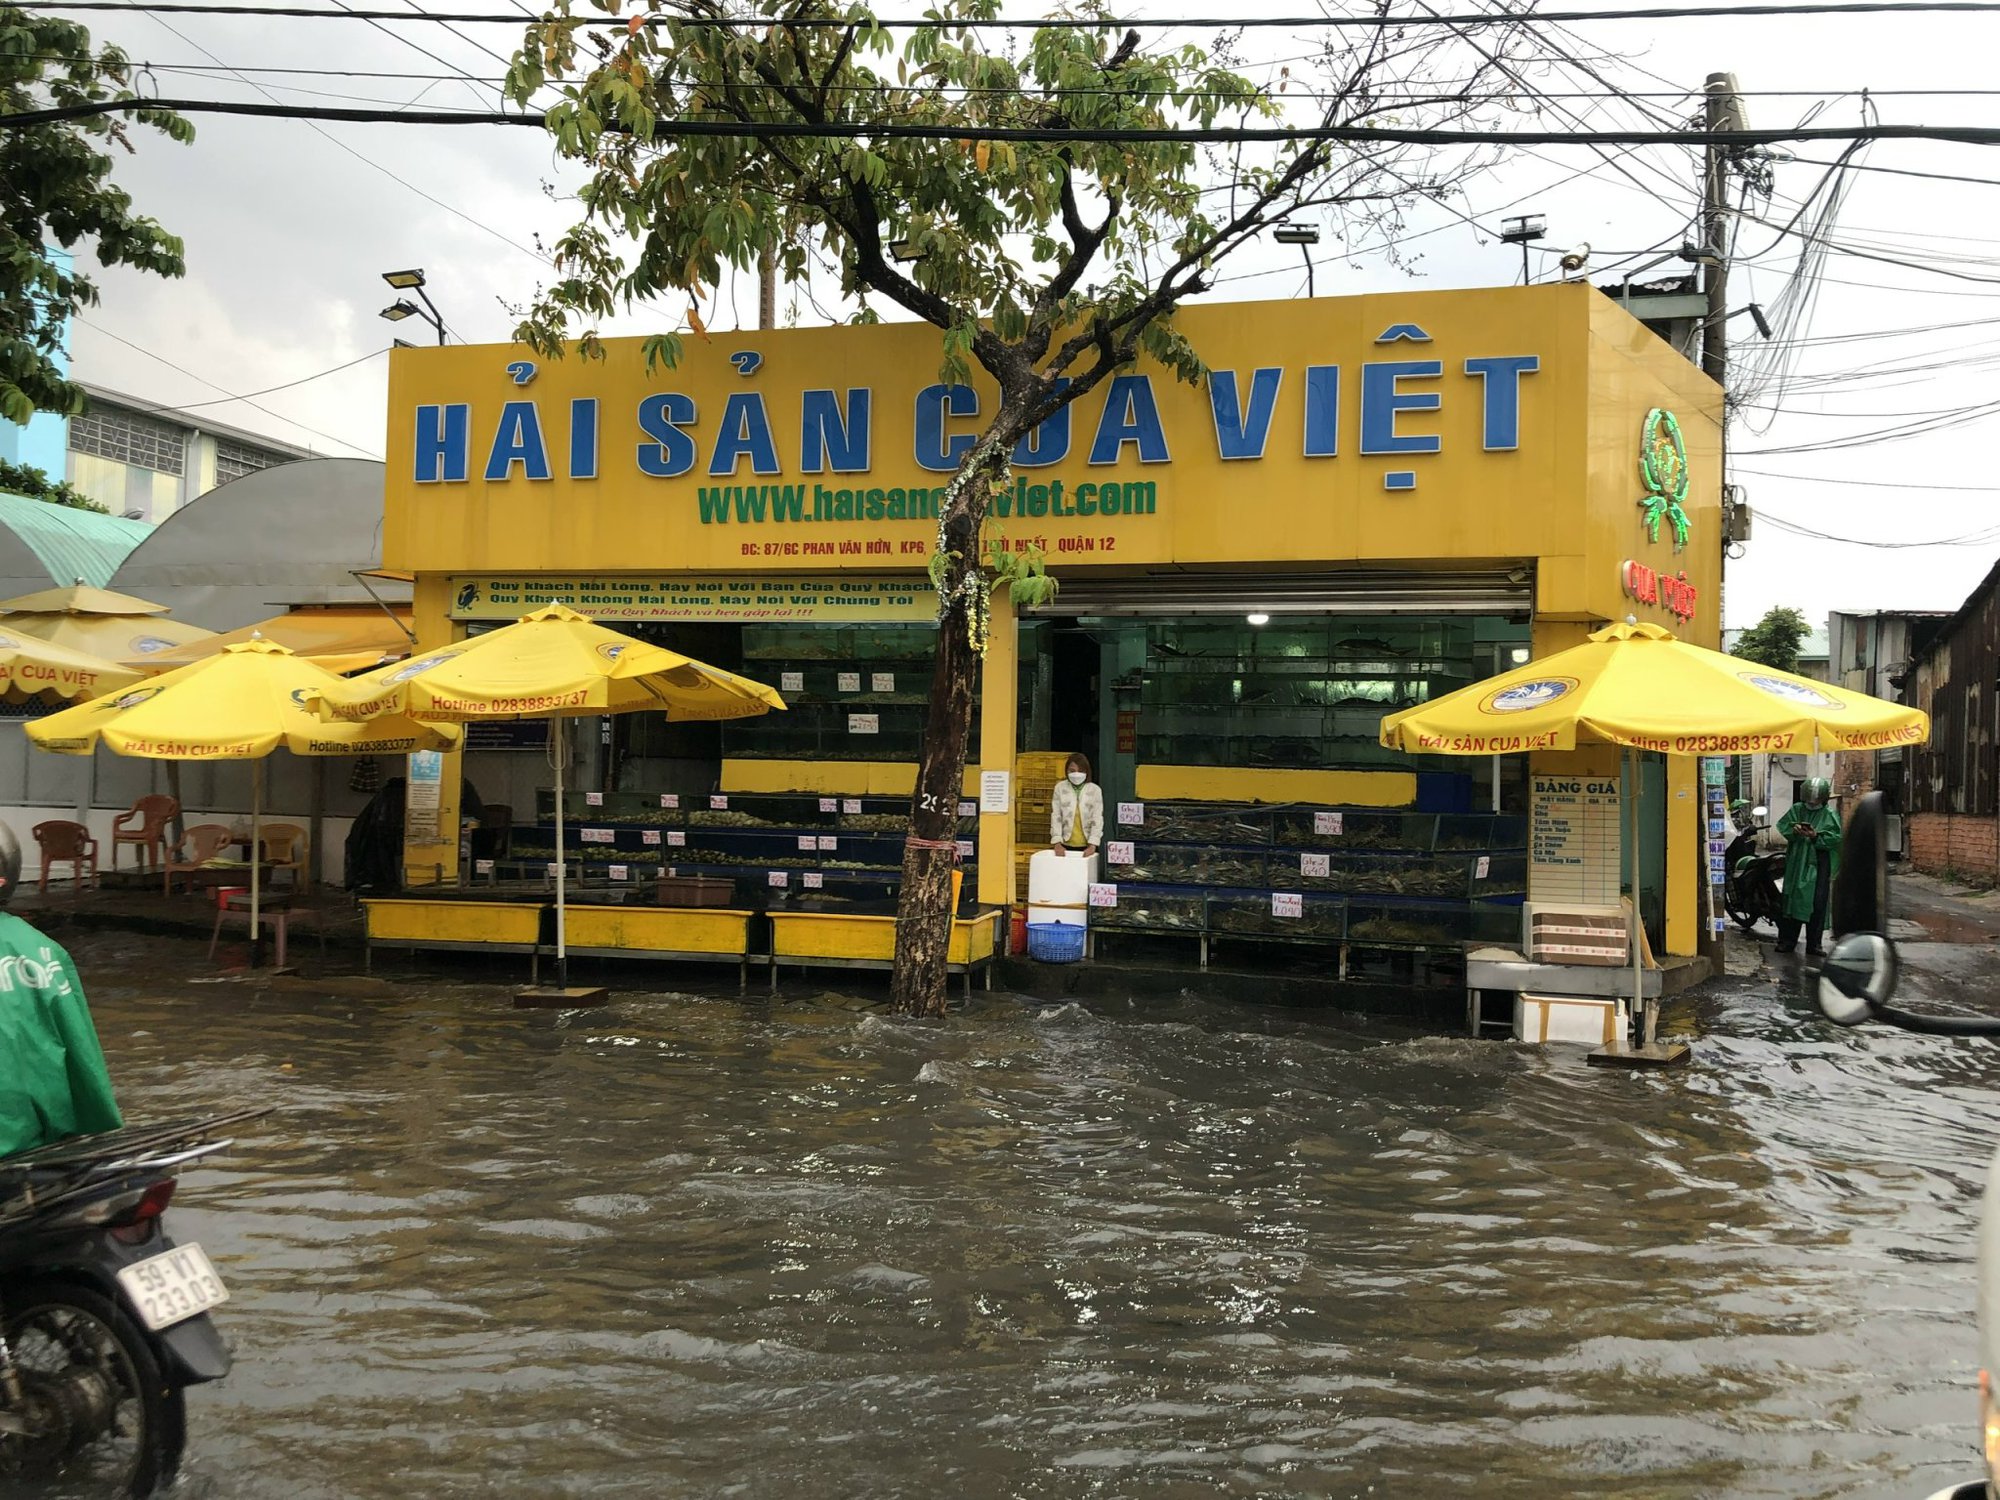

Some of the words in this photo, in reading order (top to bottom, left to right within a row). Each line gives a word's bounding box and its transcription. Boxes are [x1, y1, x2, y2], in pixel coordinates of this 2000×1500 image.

[414, 361, 599, 483] HẢI
[636, 350, 872, 478] SẢN
[1206, 323, 1541, 490] VIỆT
[698, 477, 1156, 524] WWW.haisancviet.com
[741, 543, 760, 556] ĐC:
[764, 542, 798, 556] 87/6C
[803, 541, 835, 555] PHAN
[839, 540, 862, 555] VĂN
[1058, 536, 1094, 553] QUẬN
[1099, 537, 1115, 551] 12
[21, 665, 58, 681] CUA
[62, 668, 98, 688] VIỆT
[432, 694, 486, 712] Hotline
[492, 690, 588, 711] 02838833737
[124, 739, 151, 754] HẢI
[156, 740, 187, 756] SẢN
[192, 745, 219, 756] CUA
[224, 742, 254, 756] VIỆT
[309, 739, 349, 752] Hotline
[1418, 733, 1449, 748] HẢI
[1452, 734, 1485, 751] SẢN
[1489, 737, 1521, 751] CUA
[1525, 732, 1558, 751] VIỆT
[1676, 733, 1794, 752] 02838833737
[1868, 731, 1893, 746] CUA
[1535, 778, 1581, 793] BẢNG
[1587, 780, 1616, 794] GIÁ
